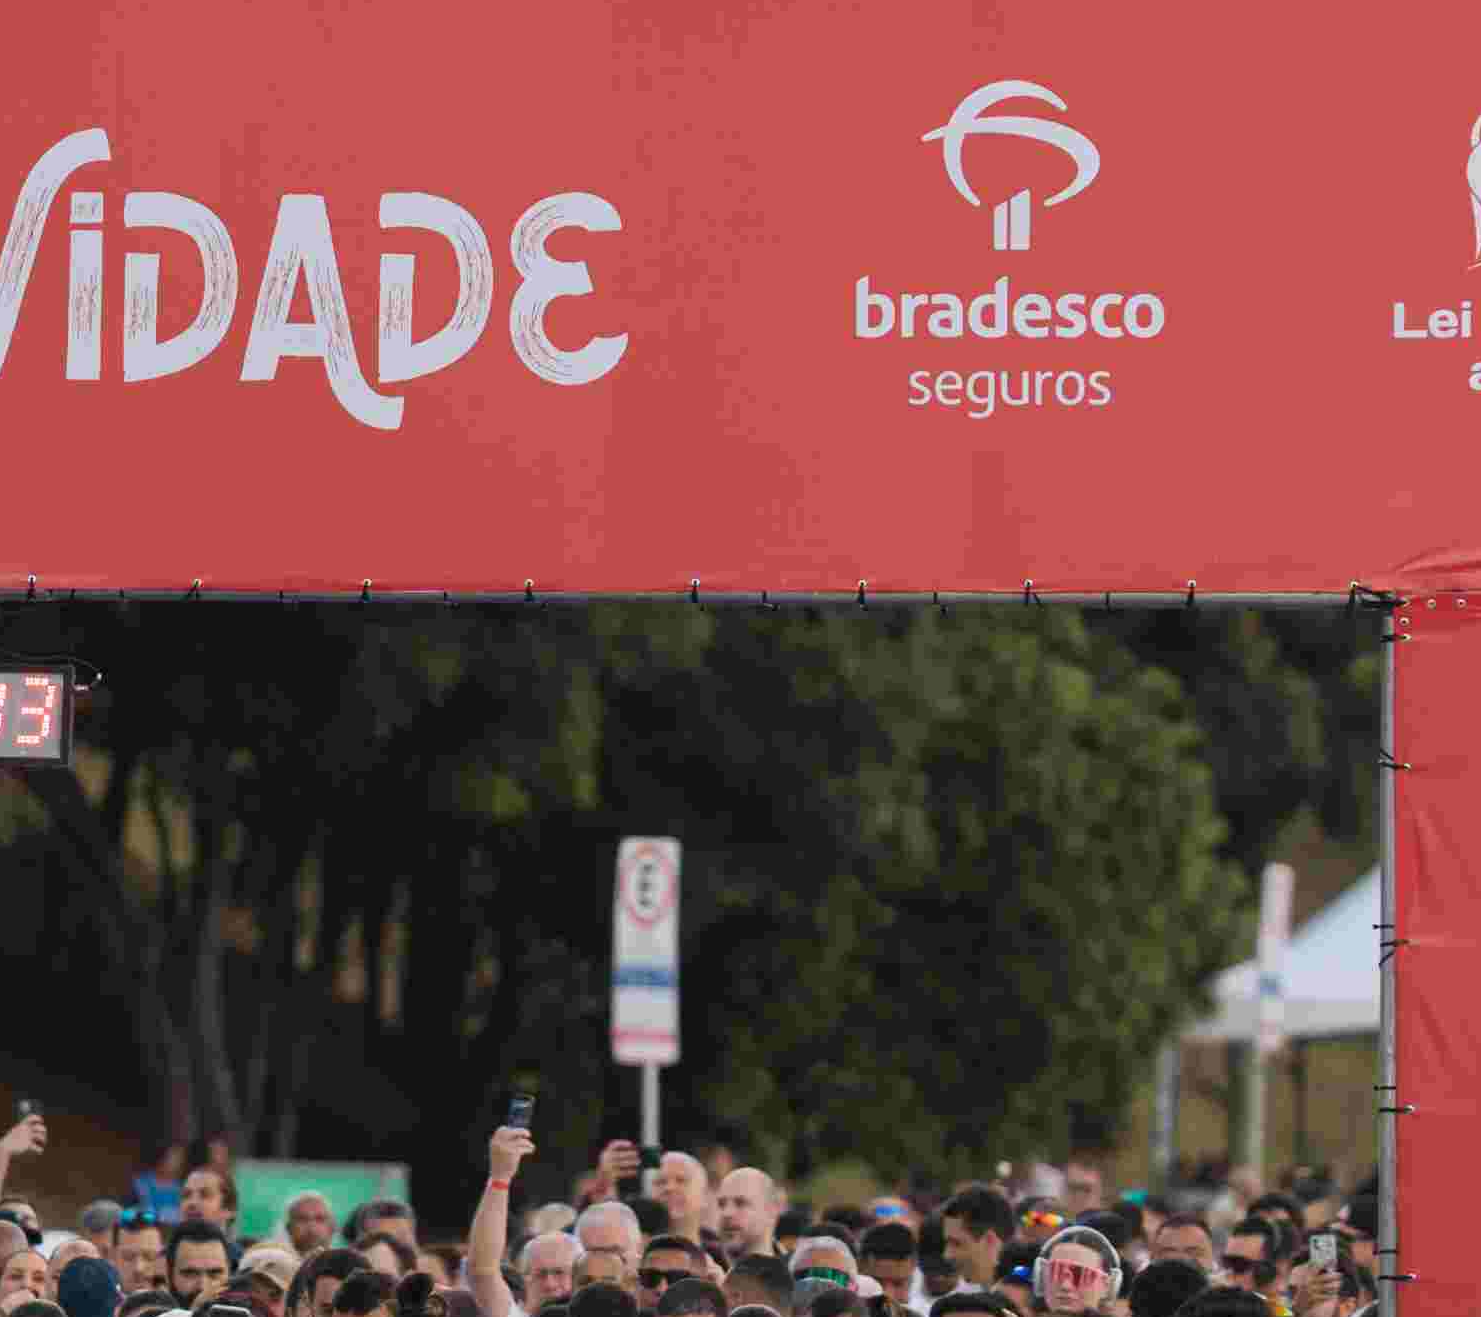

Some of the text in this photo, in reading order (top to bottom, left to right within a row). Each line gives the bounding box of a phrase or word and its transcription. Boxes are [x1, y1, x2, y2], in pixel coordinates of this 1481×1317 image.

[855, 275, 1165, 339] bradesco
[1393, 300, 1472, 339] Lei
[908, 370, 1111, 420] seguros
